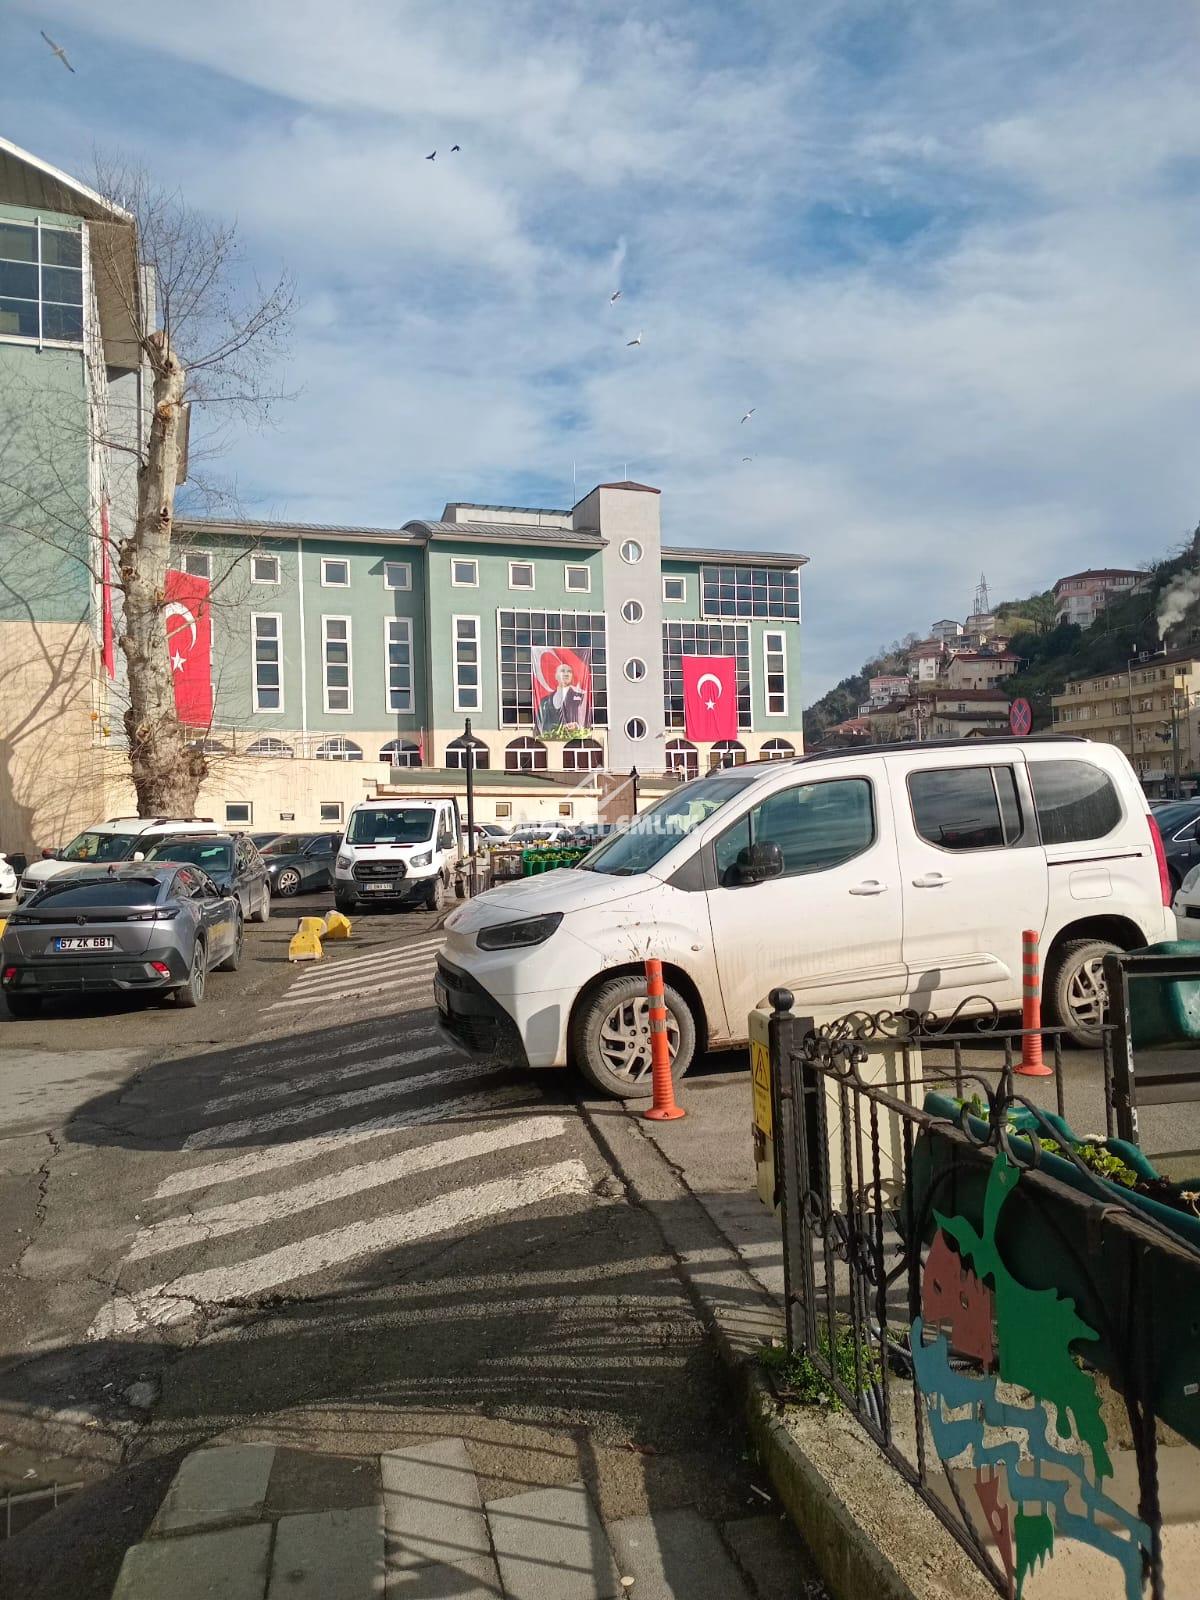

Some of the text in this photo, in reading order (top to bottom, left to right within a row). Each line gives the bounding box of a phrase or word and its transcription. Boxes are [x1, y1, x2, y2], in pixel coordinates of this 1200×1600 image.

[60, 937, 111, 948] 67 ZK 681
